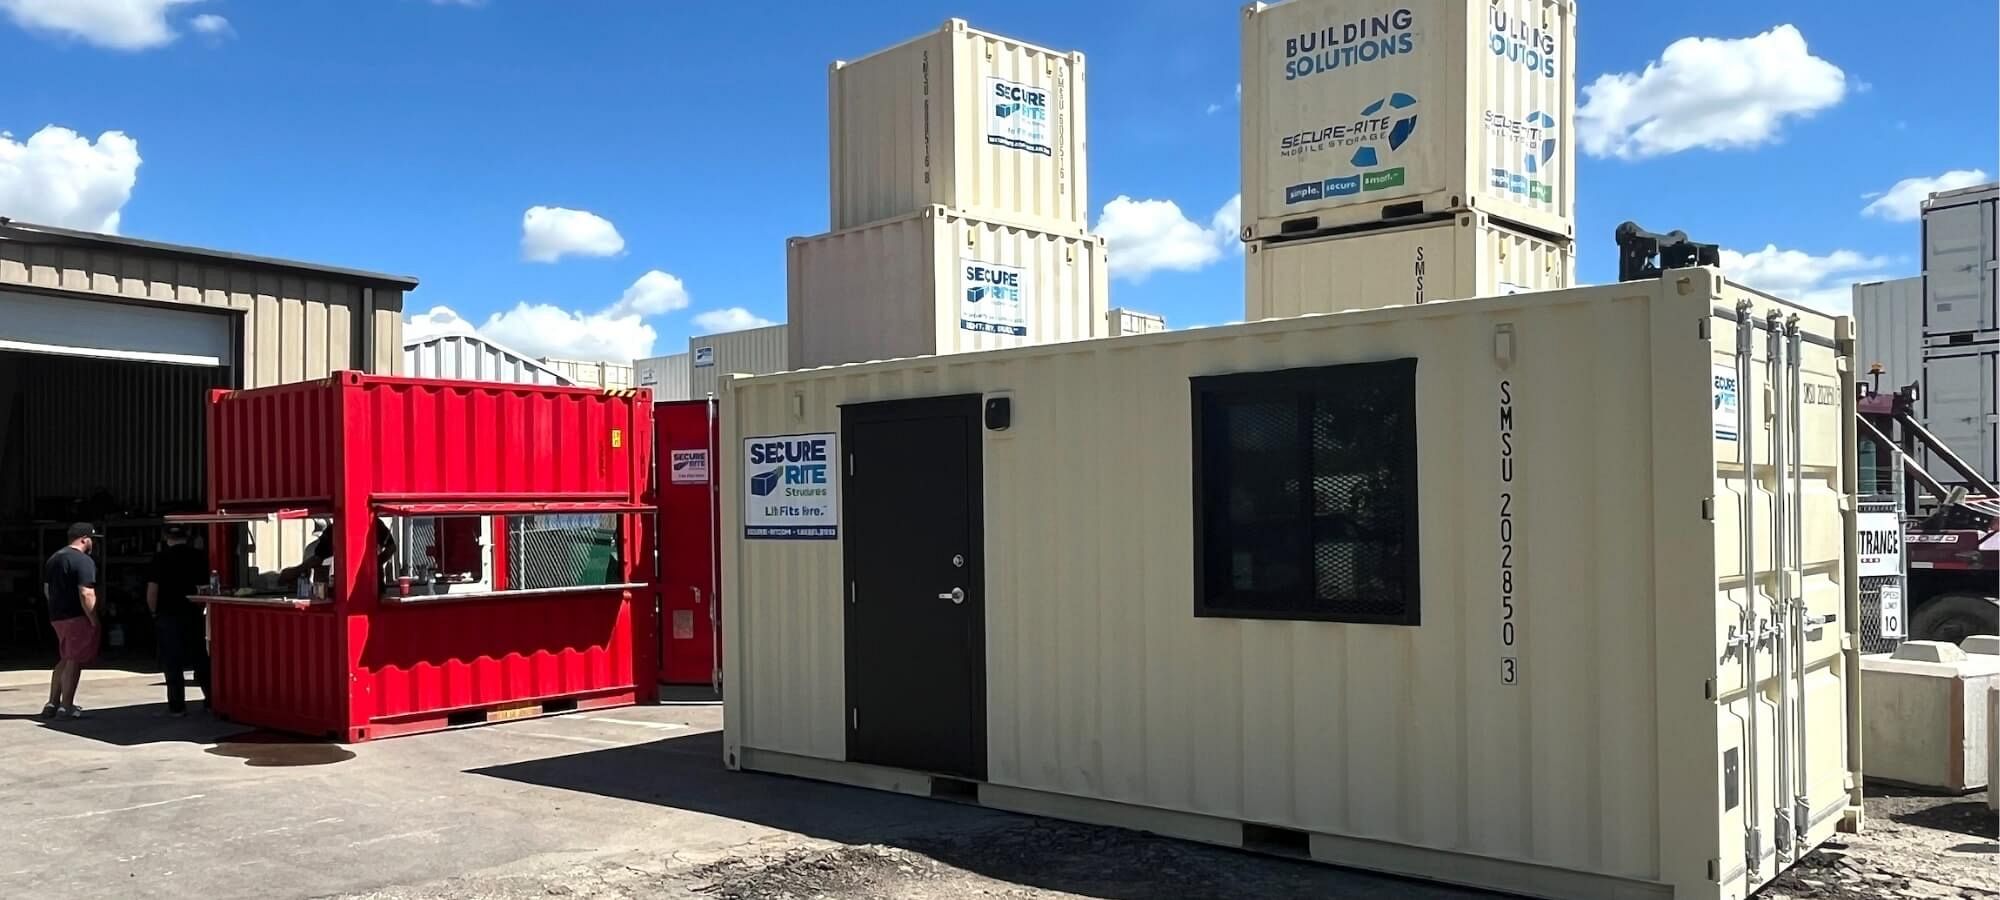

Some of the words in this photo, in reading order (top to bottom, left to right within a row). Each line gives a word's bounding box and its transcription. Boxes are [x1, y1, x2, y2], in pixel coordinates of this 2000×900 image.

[1286, 9, 1412, 58] BUILDING
[1286, 33, 1413, 80] SOLUTIONS
[996, 83, 1045, 107] SECURE
[1281, 116, 1390, 149] SECURE-RITE
[1281, 143, 1324, 157] MOBILE
[1328, 131, 1386, 148] STORAGE
[967, 267, 1018, 287] SECURE
[1415, 246, 1425, 304] SMSU
[992, 286, 1018, 302] RTE
[1500, 381, 1513, 482] SMSU
[751, 440, 826, 464] SECURE
[786, 465, 826, 484] RITE
[1858, 530, 1898, 554] TRANCE
[1500, 493, 1514, 646] 202850
[1886, 616, 1897, 631] 10
[1502, 658, 1515, 683] 3
